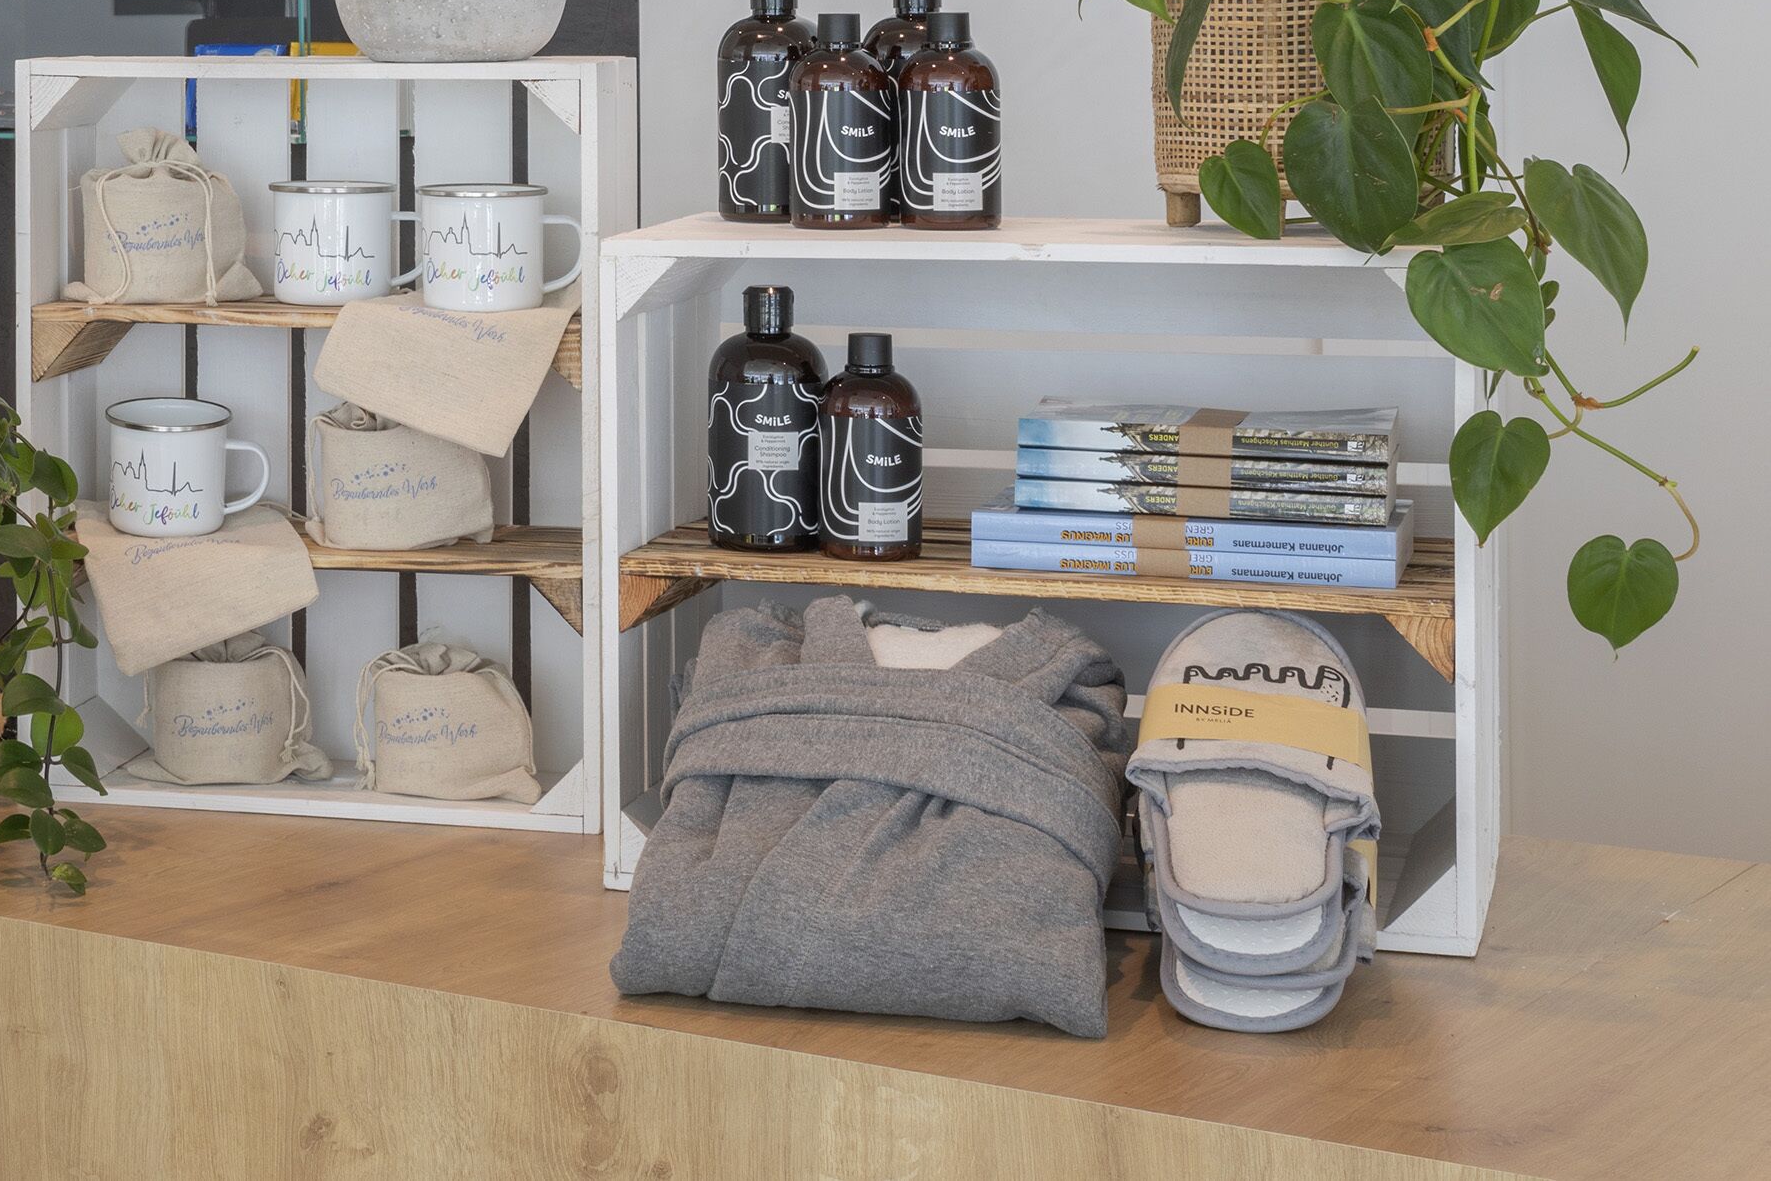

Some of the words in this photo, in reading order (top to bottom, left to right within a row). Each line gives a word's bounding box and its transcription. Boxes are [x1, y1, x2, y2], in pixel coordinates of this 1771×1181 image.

[277, 258, 314, 283] Öcher
[427, 257, 466, 283] Öcher
[1148, 433, 1179, 442] ANDERS
[1280, 439, 1309, 447] Matthias
[1147, 464, 1178, 472] ANDERS
[331, 478, 400, 499] Bezauberndes
[403, 476, 437, 499] Werk
[1145, 495, 1176, 504] ANDERS
[1060, 530, 1112, 542] MAGNUS
[1232, 539, 1295, 552] Kamermans
[1299, 542, 1344, 553] Johanna
[1060, 558, 1111, 570] MAGNUS
[1231, 567, 1294, 580] Kamermans
[1298, 572, 1343, 582] Johanna
[173, 714, 248, 737] Bezauberndes
[440, 723, 478, 745] Werk
